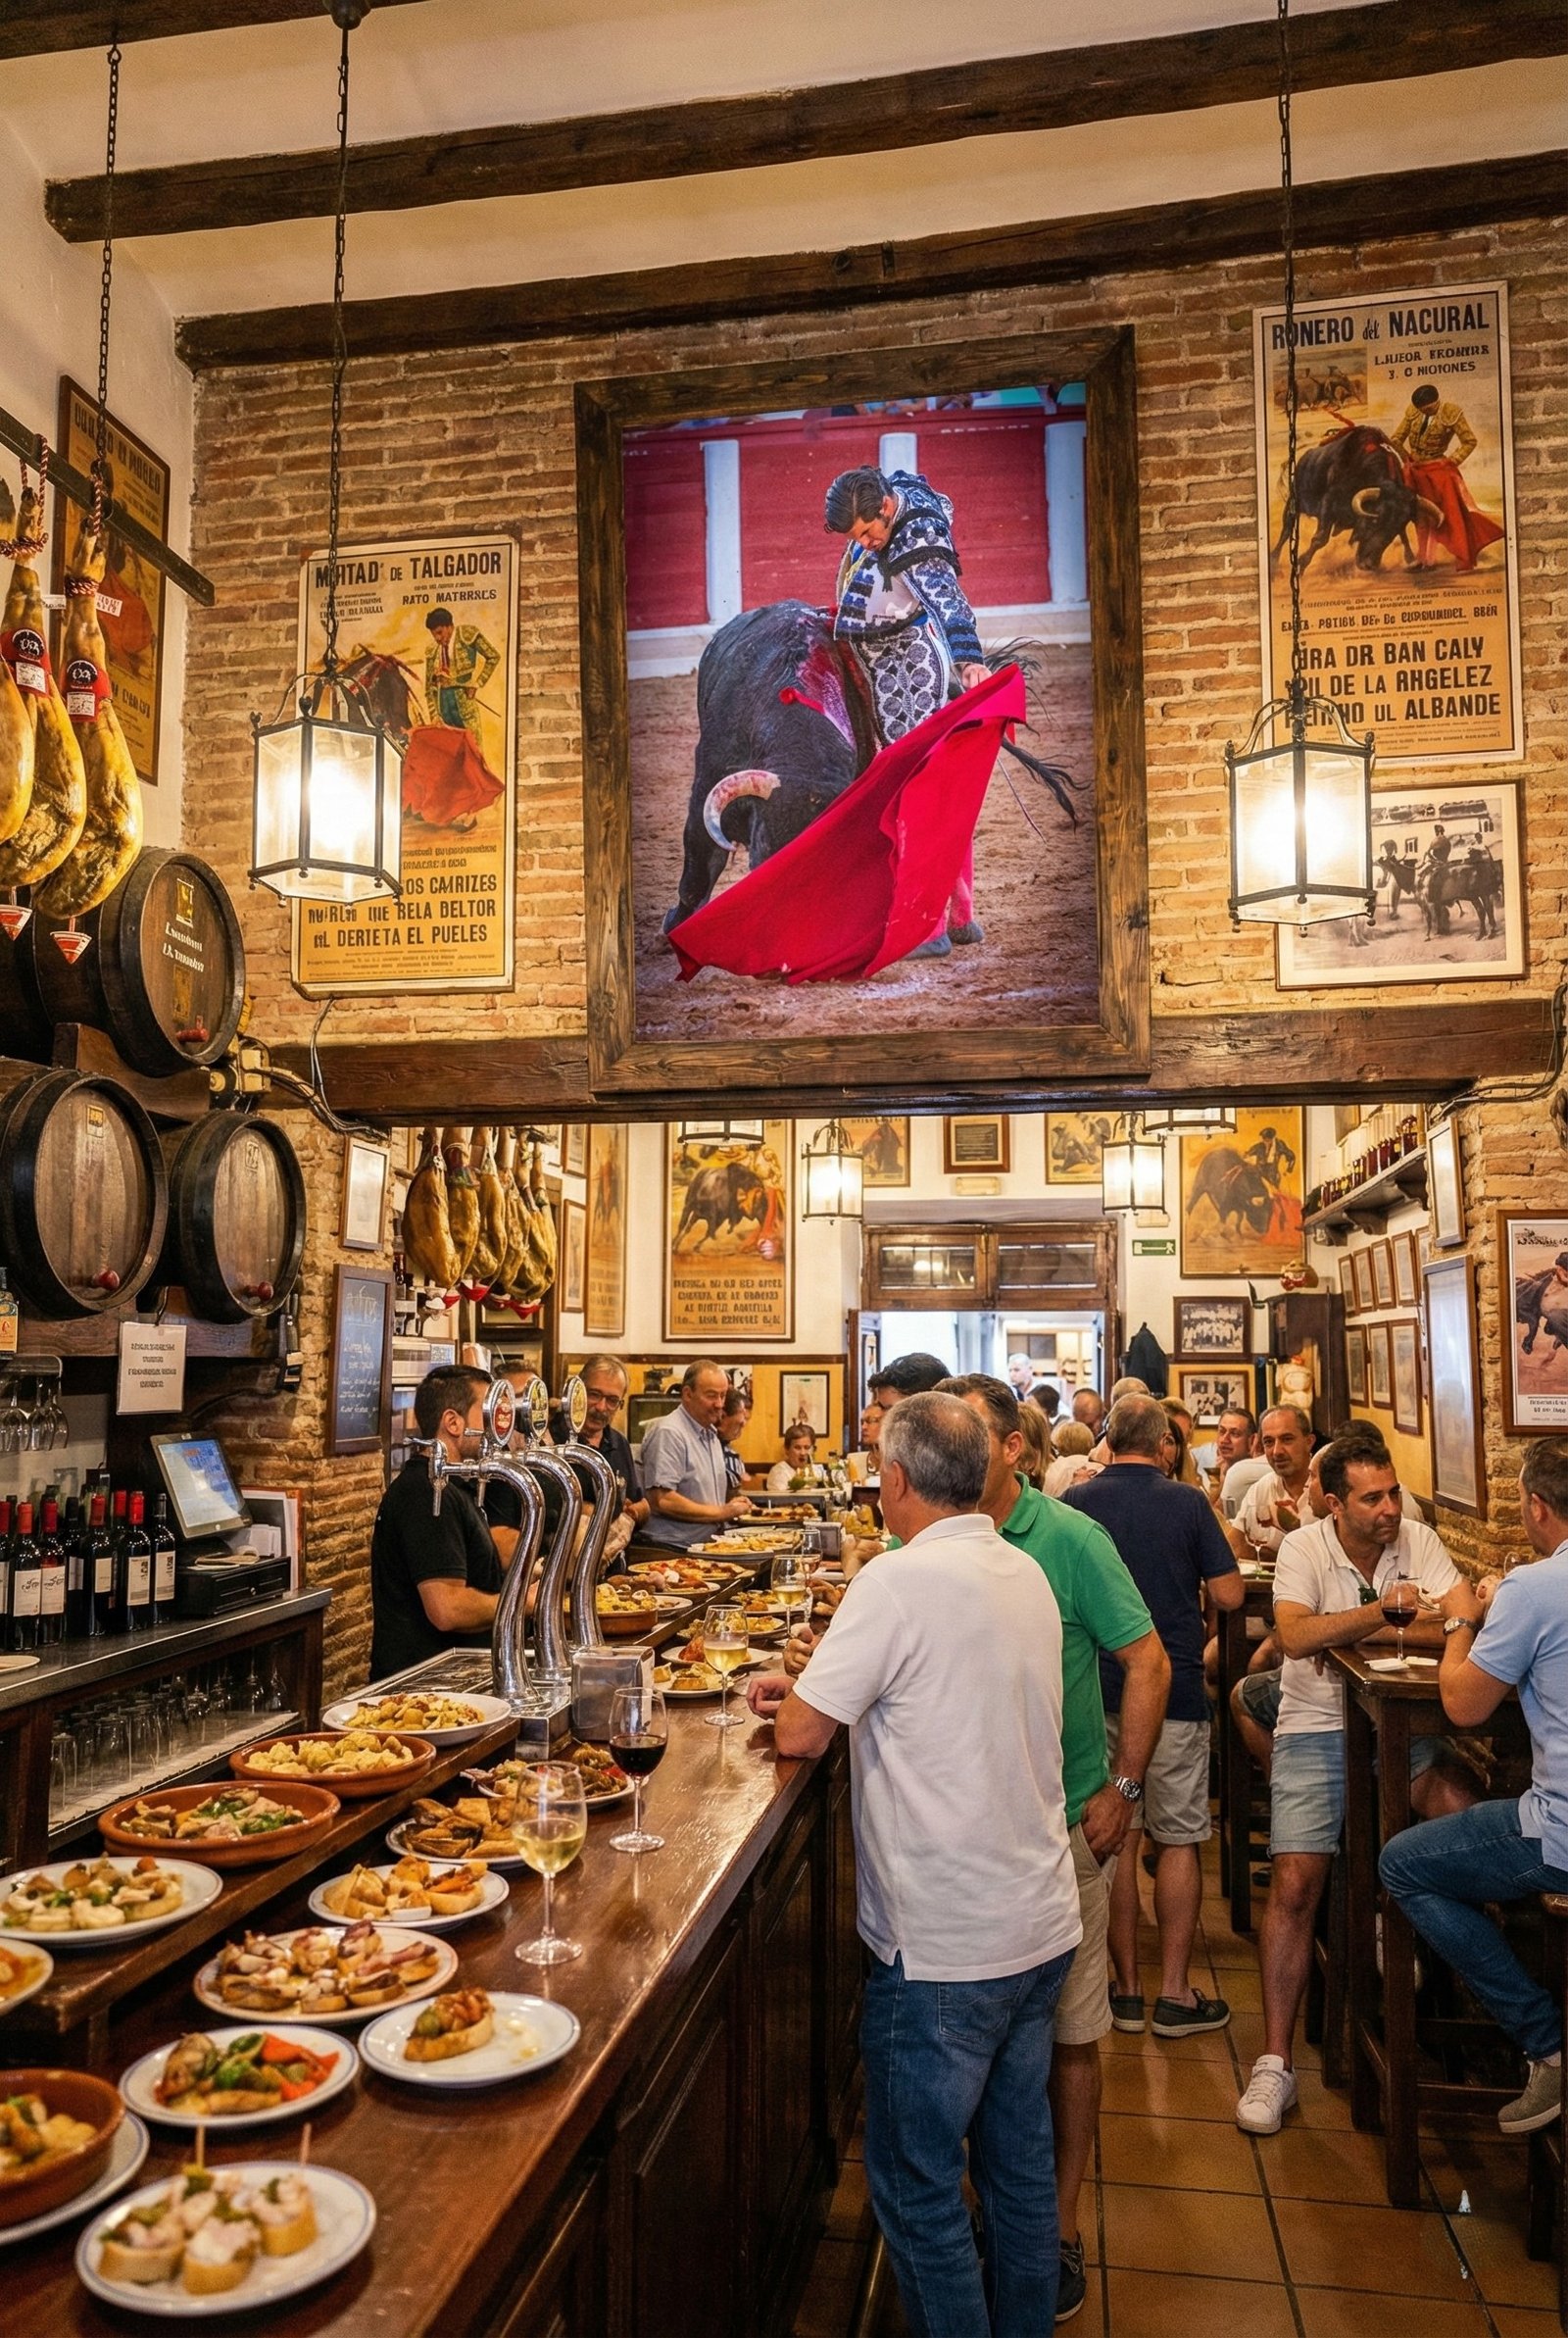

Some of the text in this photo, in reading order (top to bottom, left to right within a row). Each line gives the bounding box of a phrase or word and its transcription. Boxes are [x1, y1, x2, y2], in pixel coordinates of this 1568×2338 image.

[1389, 302, 1490, 338] NACURAL
[410, 552, 502, 579] TALGADOR
[1384, 640, 1426, 665] BAN
[1435, 636, 1484, 661] CALY
[1330, 674, 1355, 697] DE
[1364, 674, 1387, 694] LA
[1404, 693, 1501, 721] ALBANDE
[407, 926, 424, 945] EL
[431, 924, 487, 944] PUELES
